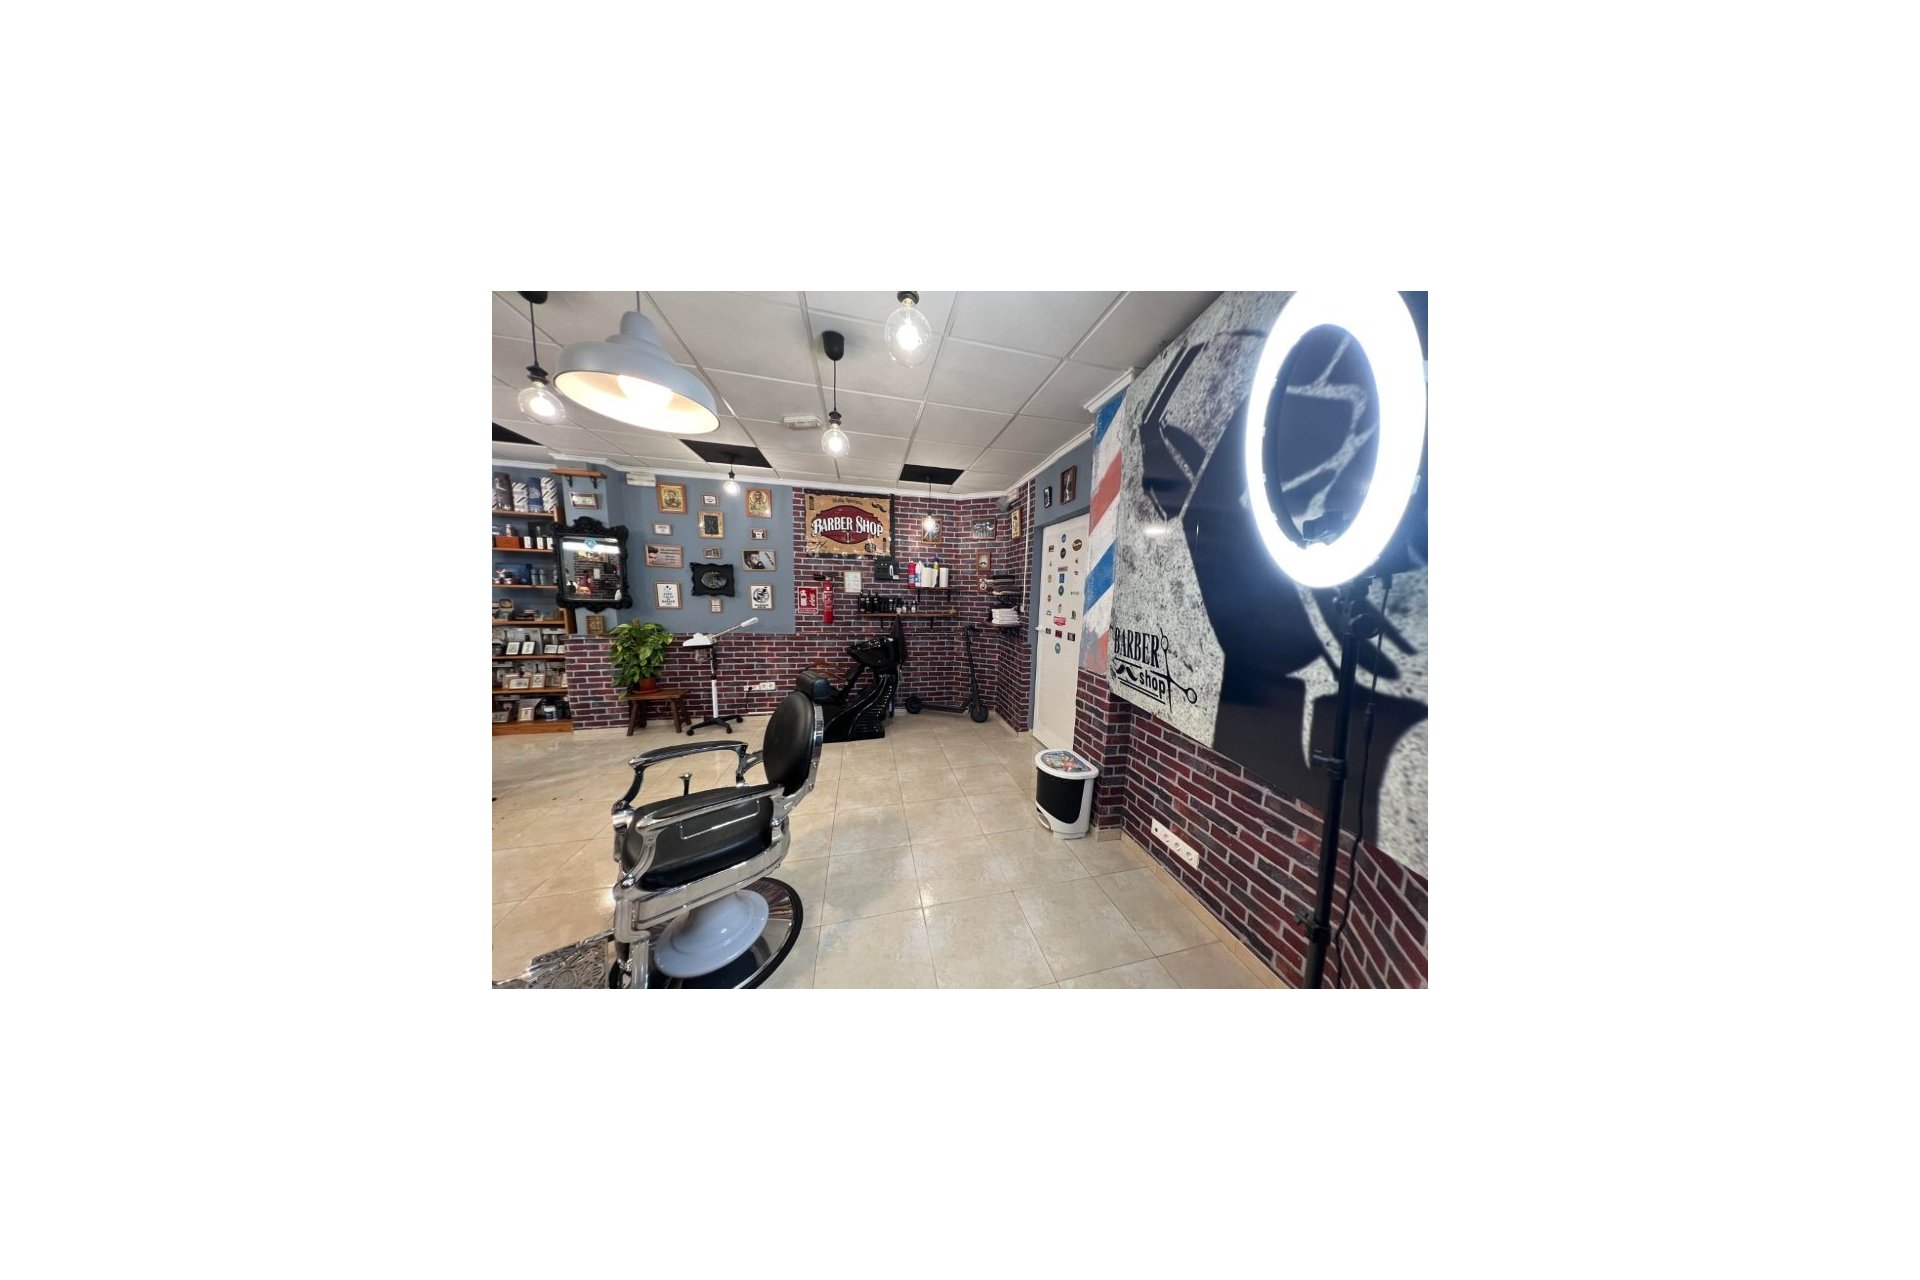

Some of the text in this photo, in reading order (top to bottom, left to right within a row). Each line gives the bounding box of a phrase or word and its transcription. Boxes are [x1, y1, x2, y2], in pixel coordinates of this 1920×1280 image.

[811, 515, 884, 537] BARBER SHOP
[1114, 627, 1160, 668] BARBER
[1139, 669, 1166, 699] shop
